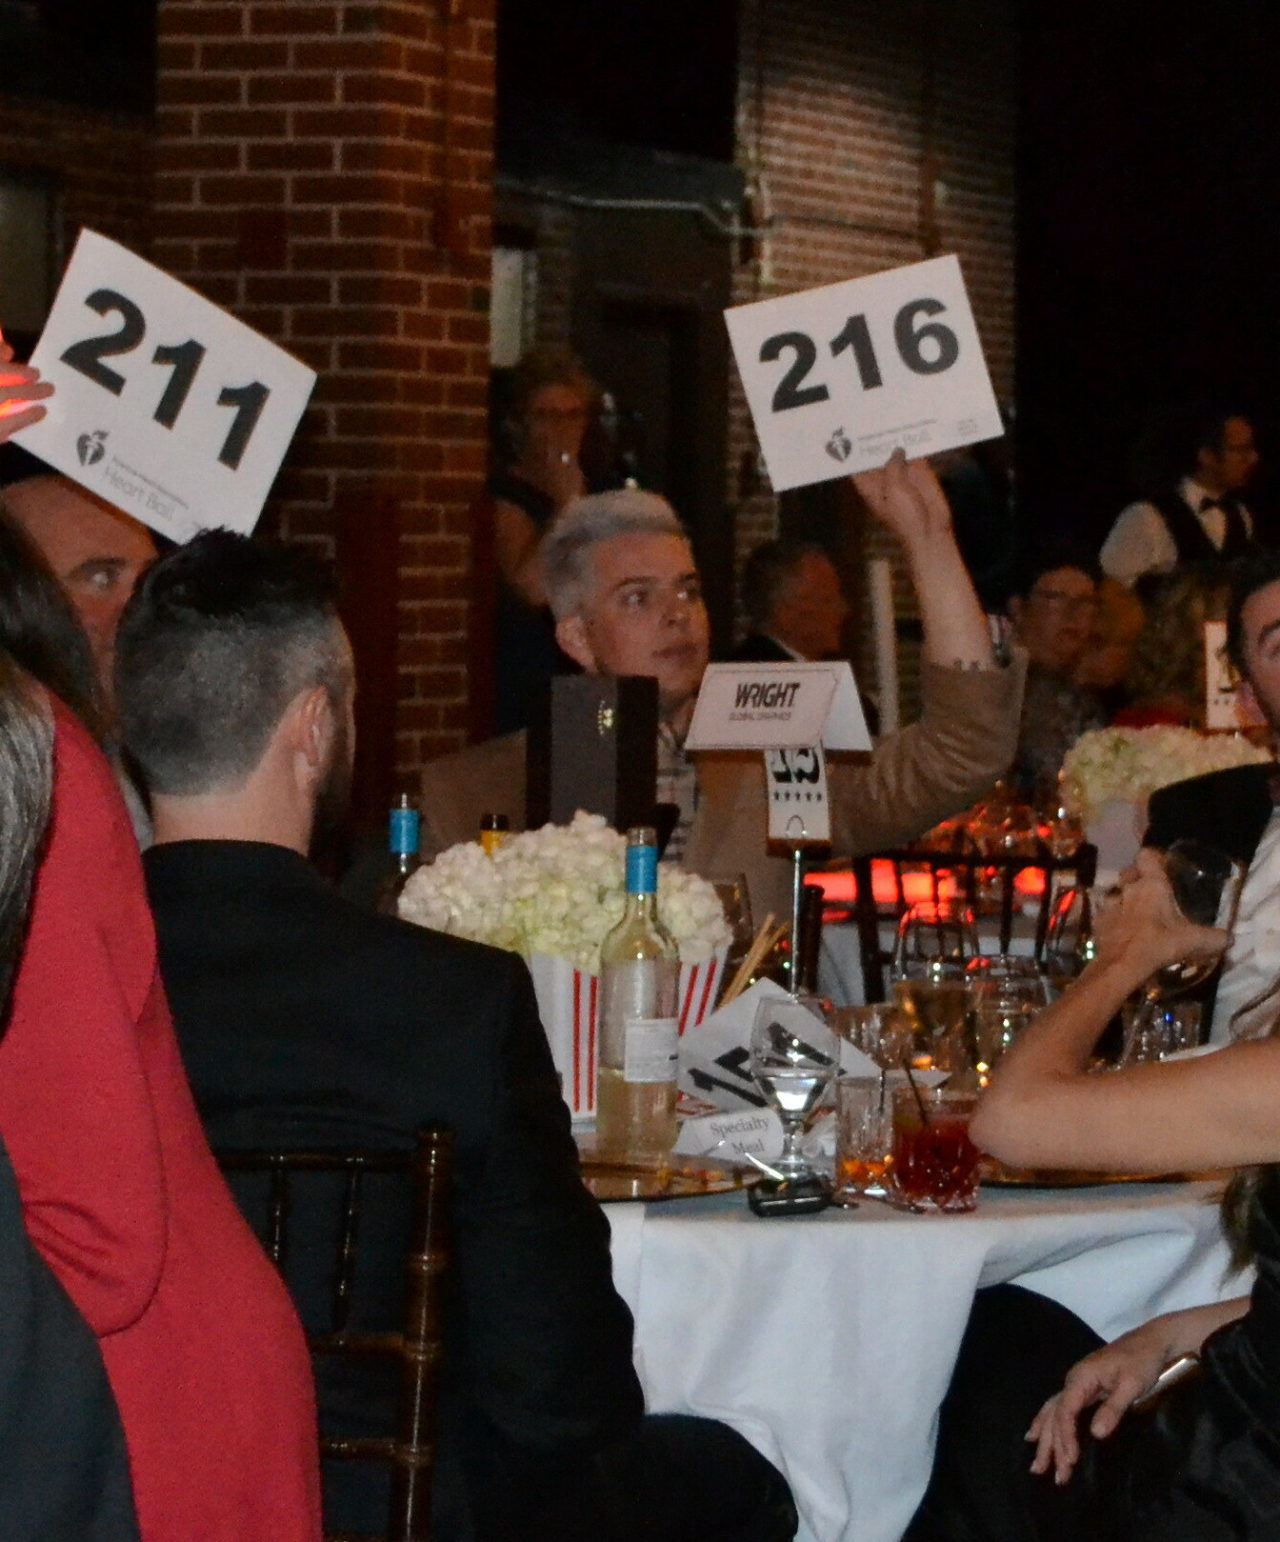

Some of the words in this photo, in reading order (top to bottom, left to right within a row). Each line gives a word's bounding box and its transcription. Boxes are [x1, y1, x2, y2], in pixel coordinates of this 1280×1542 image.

[759, 298, 959, 413] 216
[59, 288, 271, 471] 211
[735, 682, 801, 709] WRIGHT
[710, 1115, 770, 1138] Specialty
[731, 1138, 764, 1156] Meal
